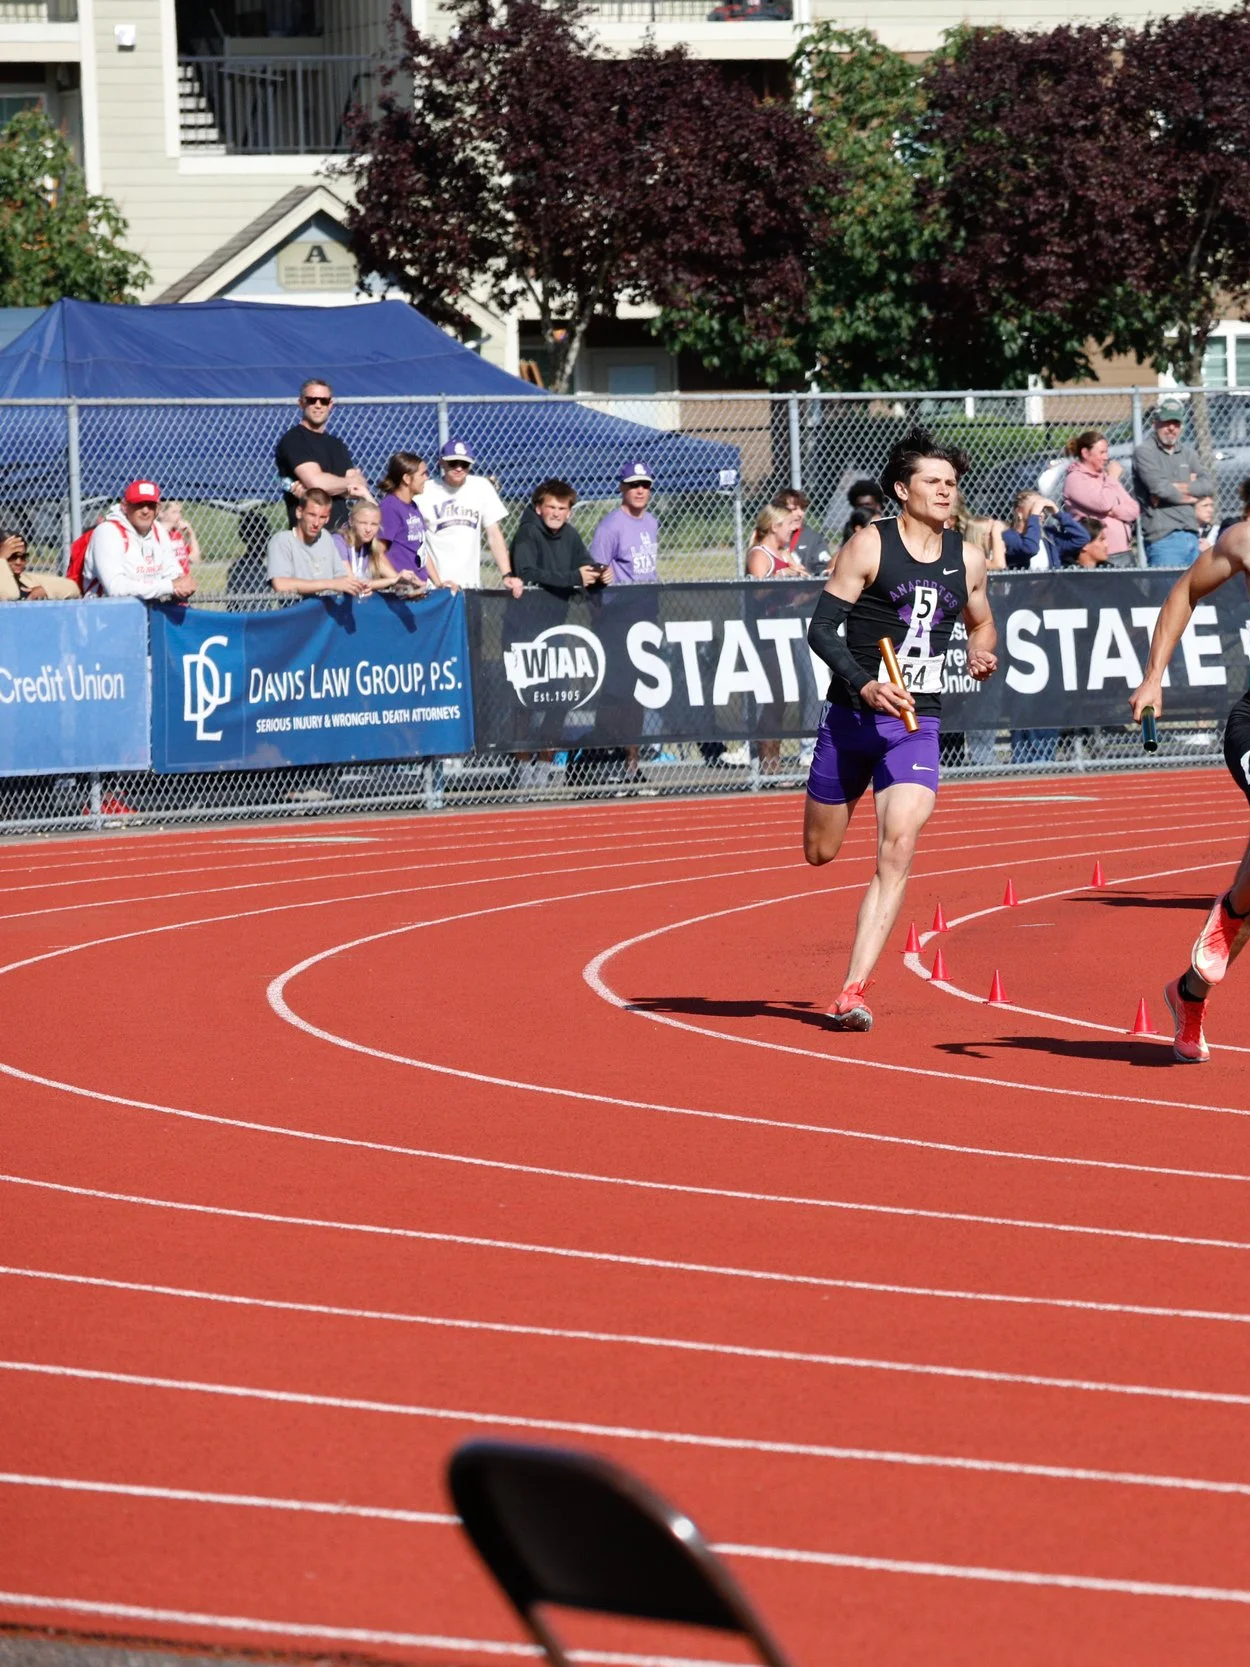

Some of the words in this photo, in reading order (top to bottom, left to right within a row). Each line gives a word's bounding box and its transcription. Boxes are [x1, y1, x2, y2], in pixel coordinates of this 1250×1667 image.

[303, 245, 332, 263] A
[916, 590, 932, 619] 5
[521, 647, 595, 679] WIAA
[0, 665, 66, 704] Credit
[67, 663, 125, 701] Union
[249, 668, 305, 703] DAVIS
[310, 664, 350, 699] LAW
[356, 660, 426, 696] GROUP,
[430, 661, 462, 690] P.S.
[256, 717, 292, 733] SERIOUS
[293, 714, 323, 730] INJURY
[324, 714, 331, 728] &
[331, 711, 381, 728] WRONGFUL
[383, 708, 410, 724] DEATH
[411, 705, 460, 722] ATTORNEYS
